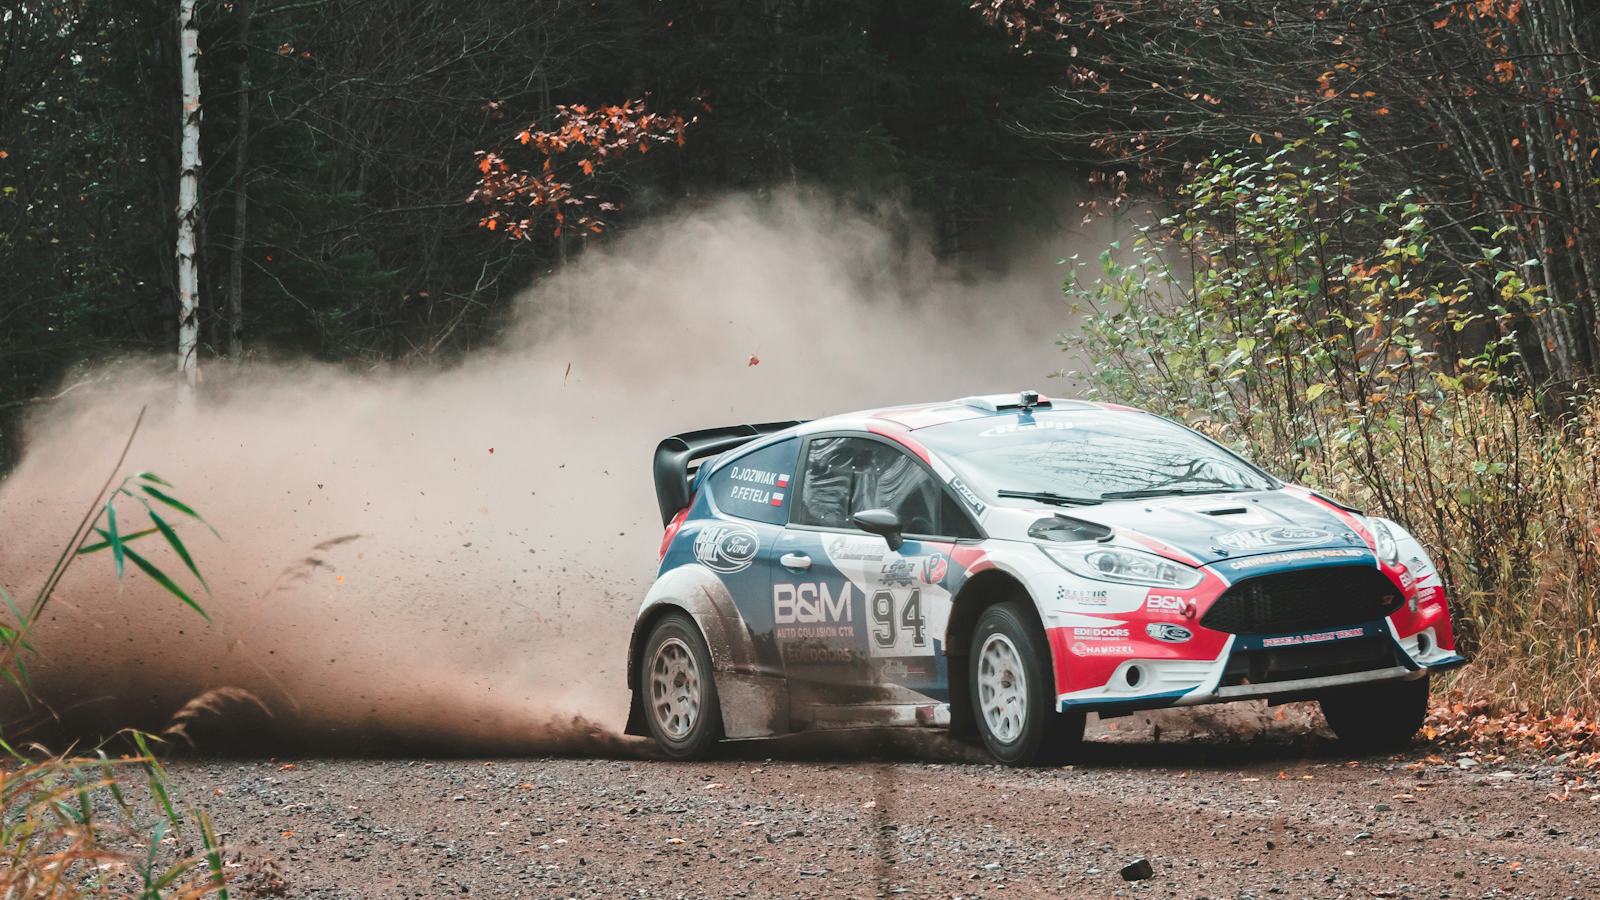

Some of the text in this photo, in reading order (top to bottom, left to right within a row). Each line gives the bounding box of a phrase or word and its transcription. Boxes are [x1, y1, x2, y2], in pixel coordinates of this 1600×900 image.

[731, 467, 777, 485] D.JOZWIAK
[731, 486, 770, 504] P.FETELA
[727, 536, 752, 554] Ford
[773, 582, 853, 624] B&M
[1146, 595, 1197, 609] B&M
[871, 587, 926, 648] 94
[777, 628, 796, 639] AUTO
